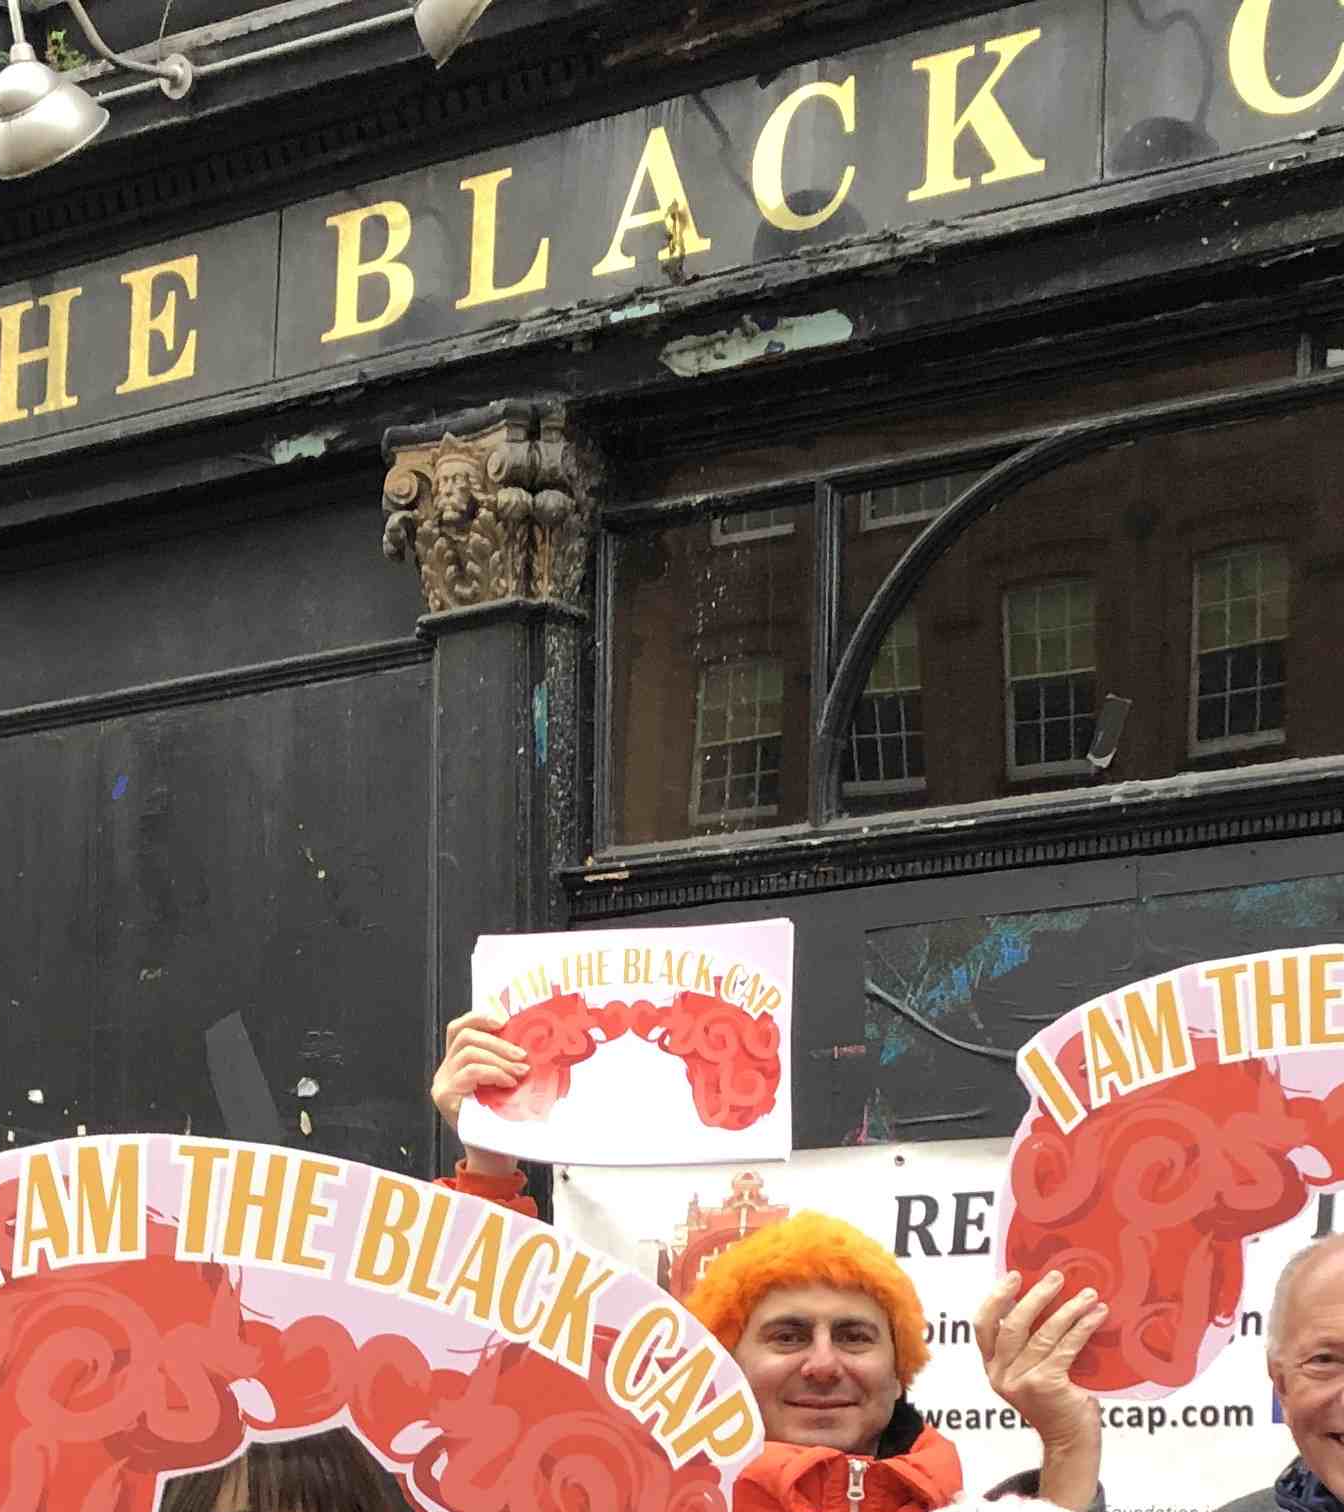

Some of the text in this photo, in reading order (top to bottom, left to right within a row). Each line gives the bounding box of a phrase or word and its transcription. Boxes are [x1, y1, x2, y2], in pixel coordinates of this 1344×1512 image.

[319, 26, 1045, 345] BLACK
[560, 947, 612, 991] THE
[623, 947, 716, 991] BLACK
[723, 963, 783, 1016] CAP
[1024, 1046, 1078, 1125] I
[1087, 990, 1189, 1098] AM
[21, 1144, 140, 1258] AM
[179, 1145, 341, 1270] THE
[356, 1177, 613, 1366] BLACK
[612, 1306, 755, 1461] CAP
